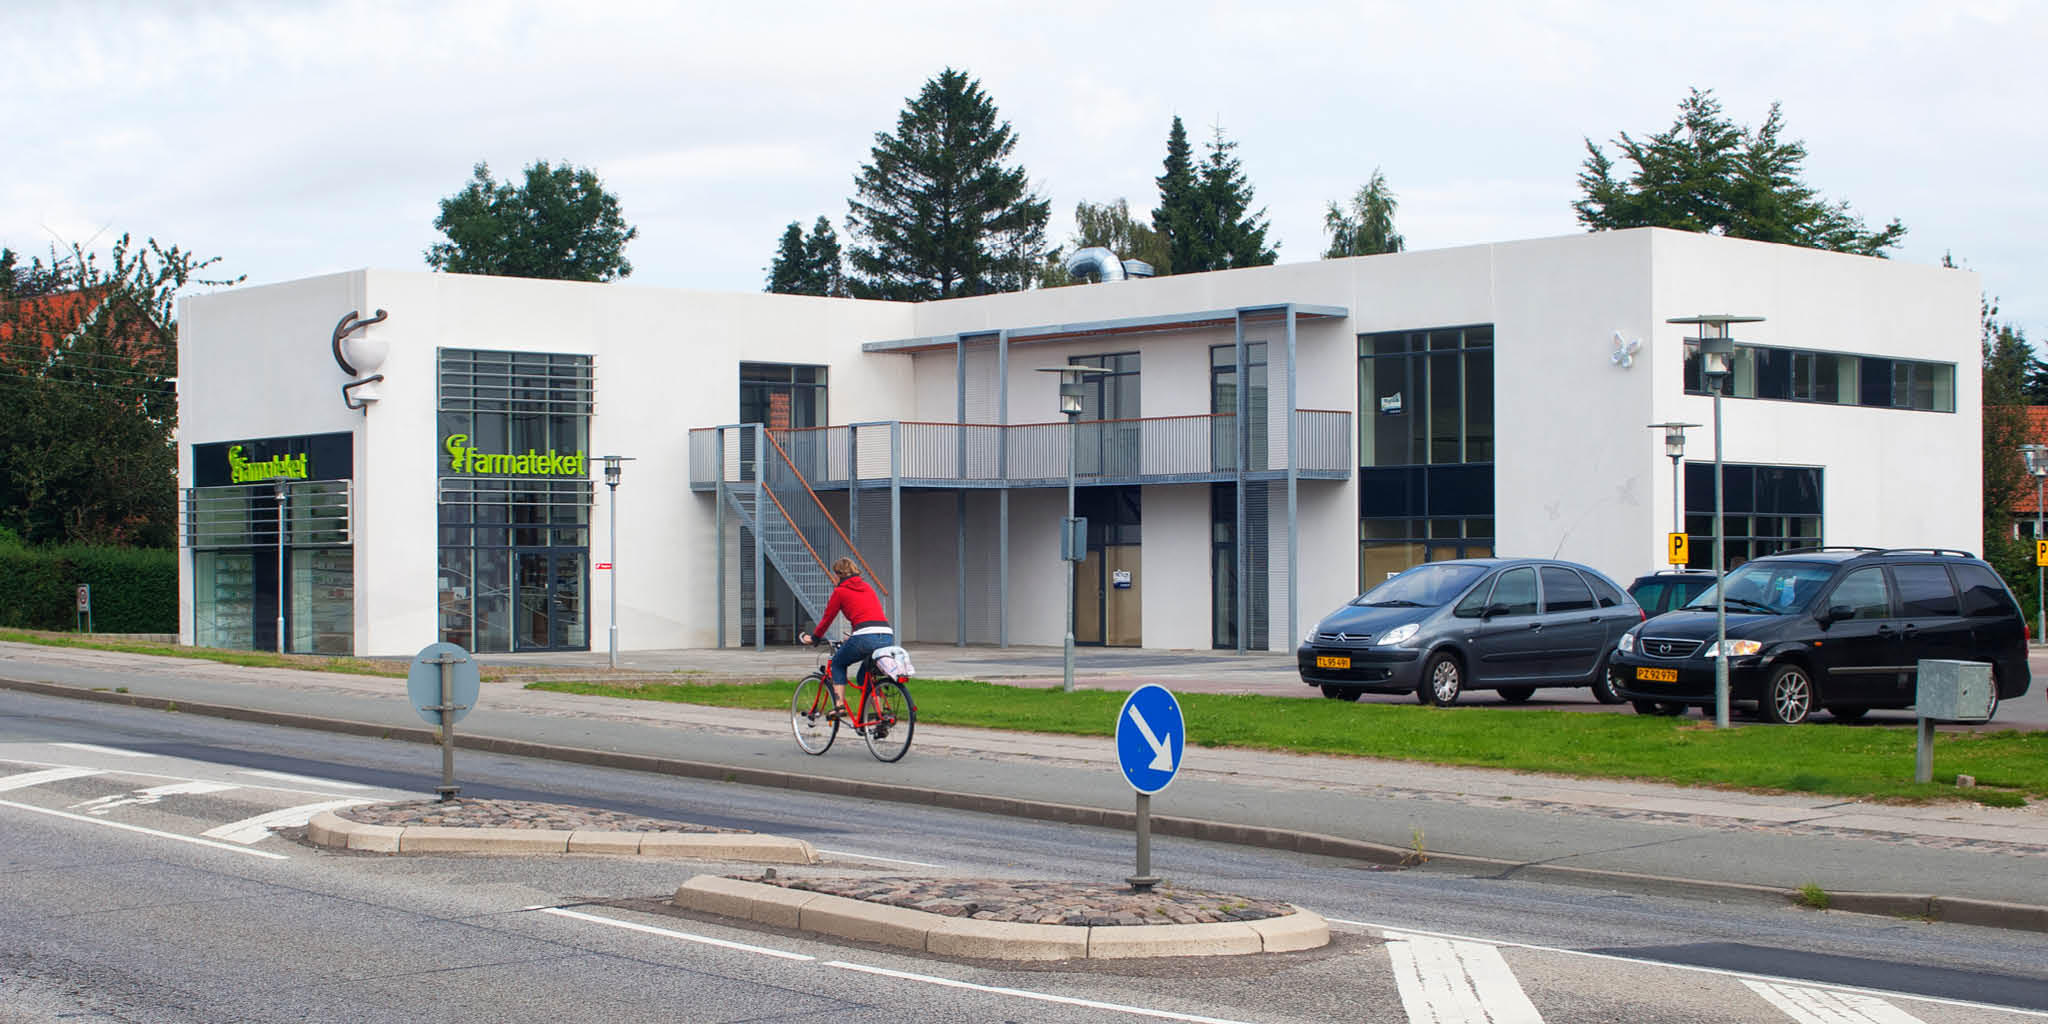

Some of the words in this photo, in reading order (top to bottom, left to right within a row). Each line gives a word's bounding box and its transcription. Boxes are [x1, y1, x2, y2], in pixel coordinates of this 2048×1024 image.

[466, 447, 585, 475] Farmateket
[1674, 536, 1683, 556] P
[2040, 542, 2047, 560] P
